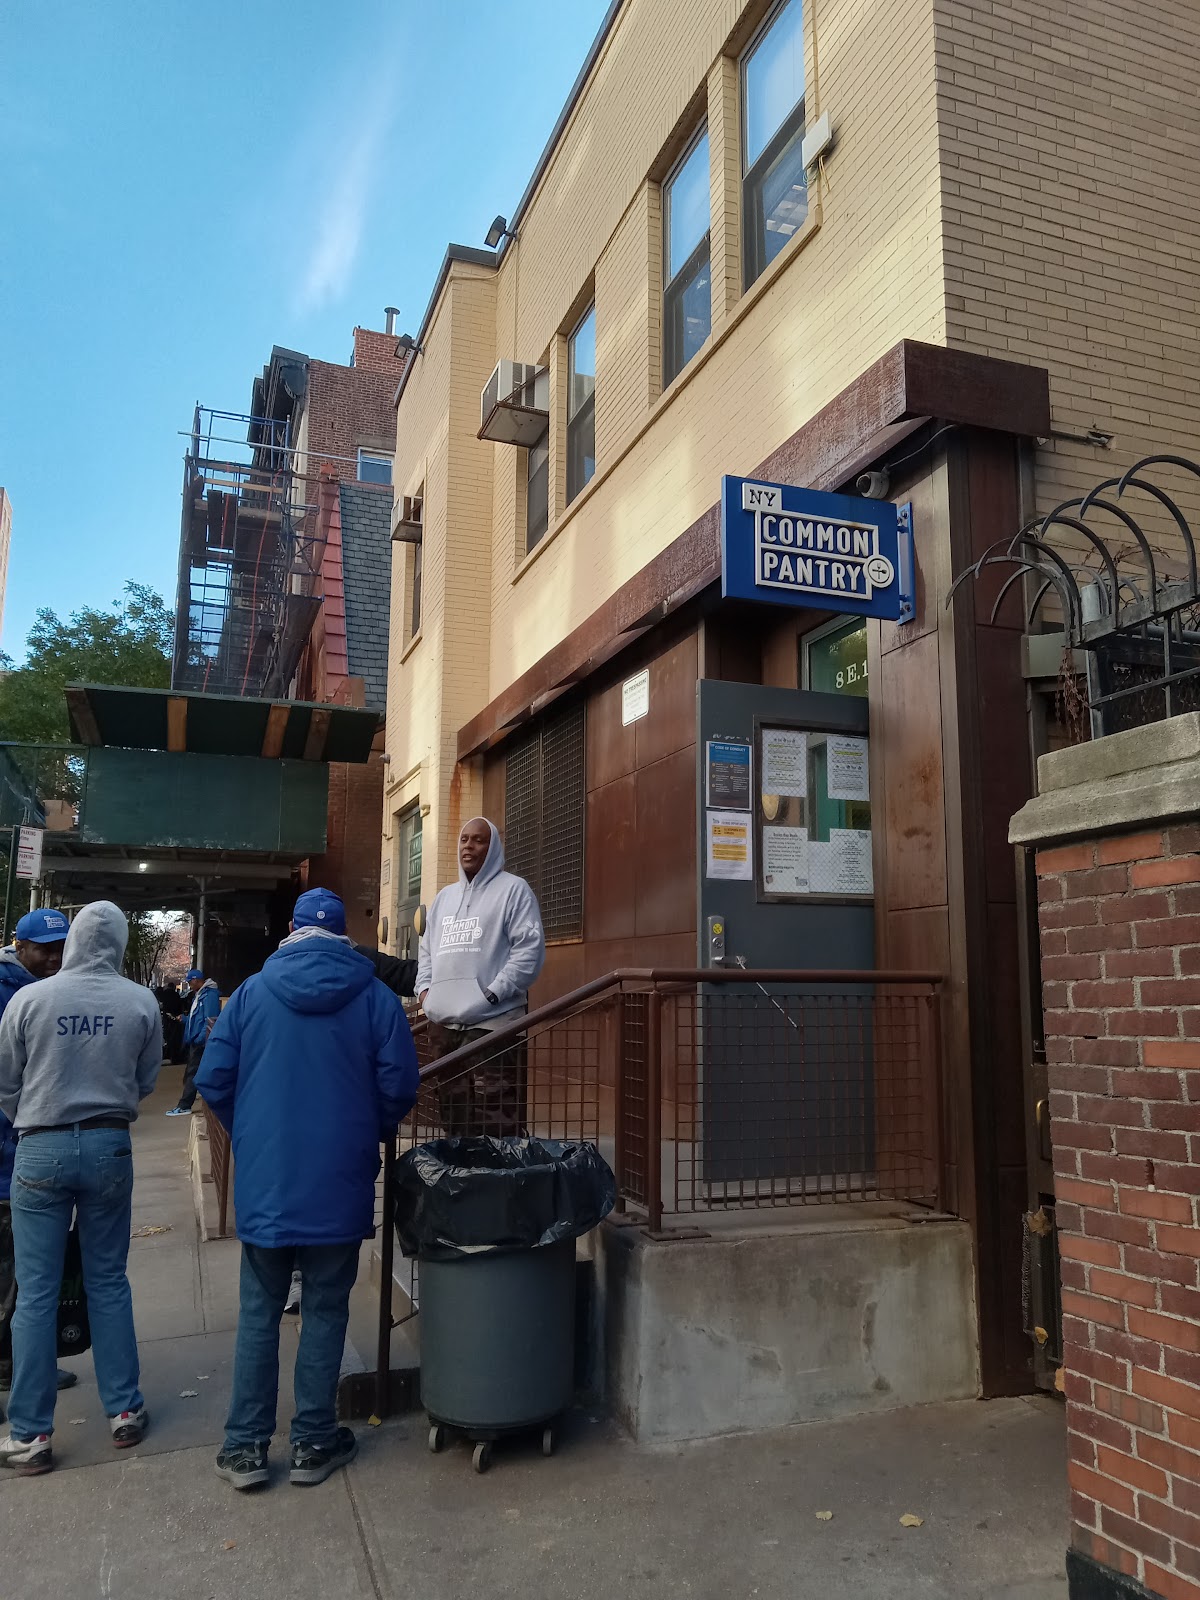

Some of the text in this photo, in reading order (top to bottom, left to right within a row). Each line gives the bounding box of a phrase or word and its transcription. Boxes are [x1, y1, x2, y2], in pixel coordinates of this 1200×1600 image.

[749, 489, 777, 507] NY
[763, 516, 869, 557] COMMON
[764, 552, 861, 591] PANTRY
[444, 919, 475, 934] COMMON
[442, 932, 470, 945] PANTRY
[57, 1015, 115, 1036] STAFF
